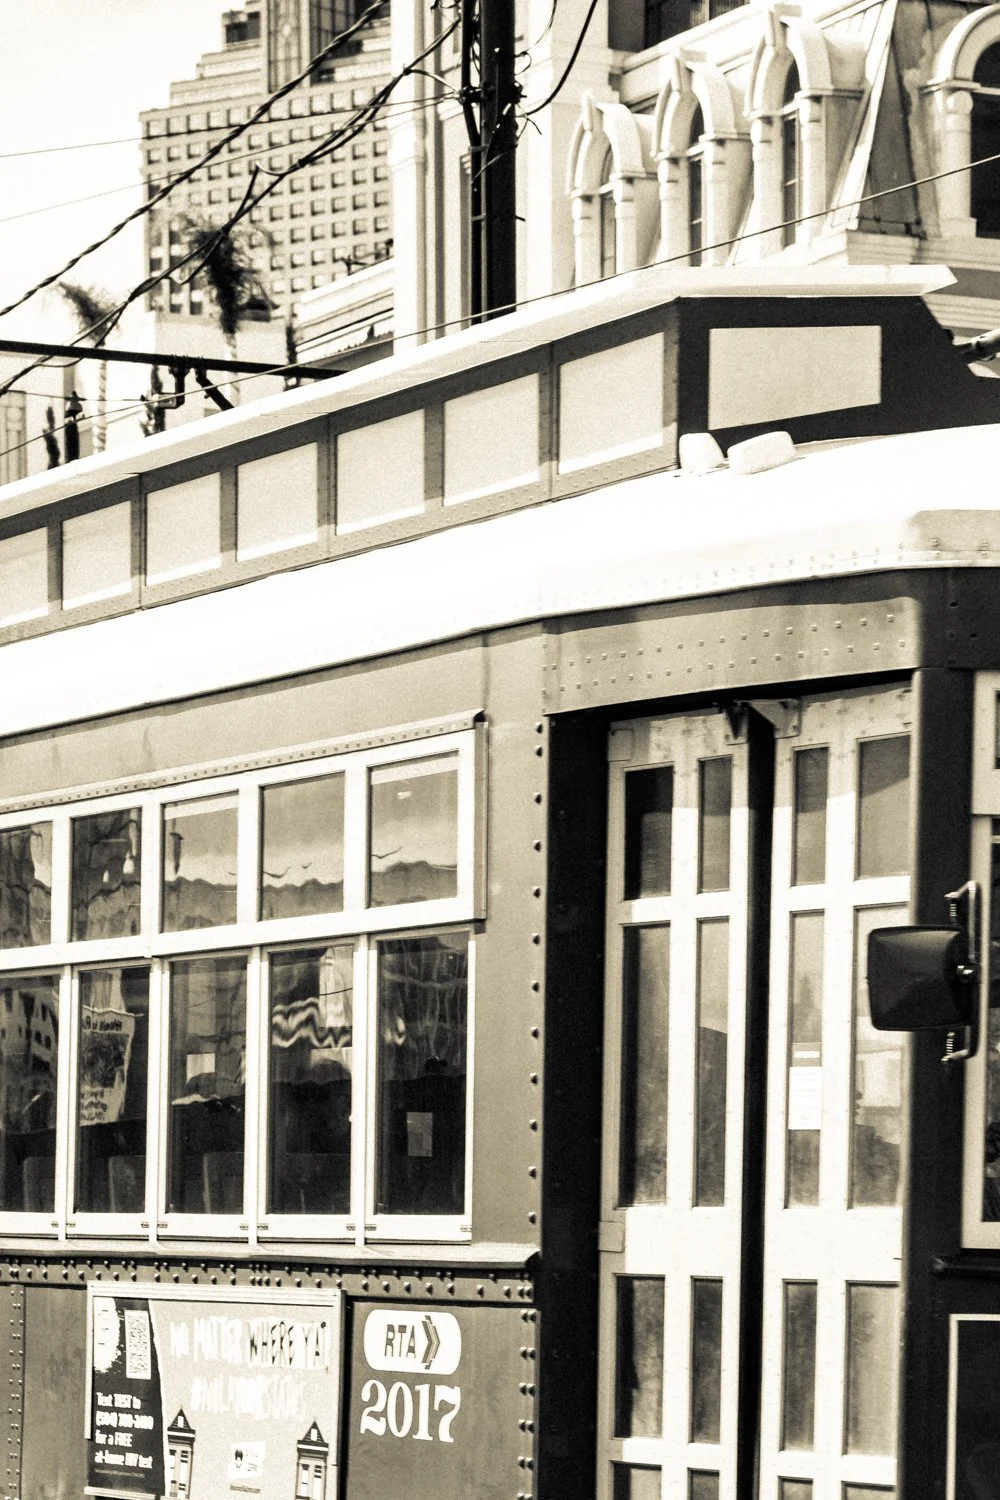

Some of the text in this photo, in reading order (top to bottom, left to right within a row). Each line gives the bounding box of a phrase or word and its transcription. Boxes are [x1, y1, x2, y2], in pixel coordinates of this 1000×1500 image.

[247, 1317, 297, 1368] WHERE
[384, 1323, 417, 1359] RTA
[360, 1379, 461, 1443] 2017
